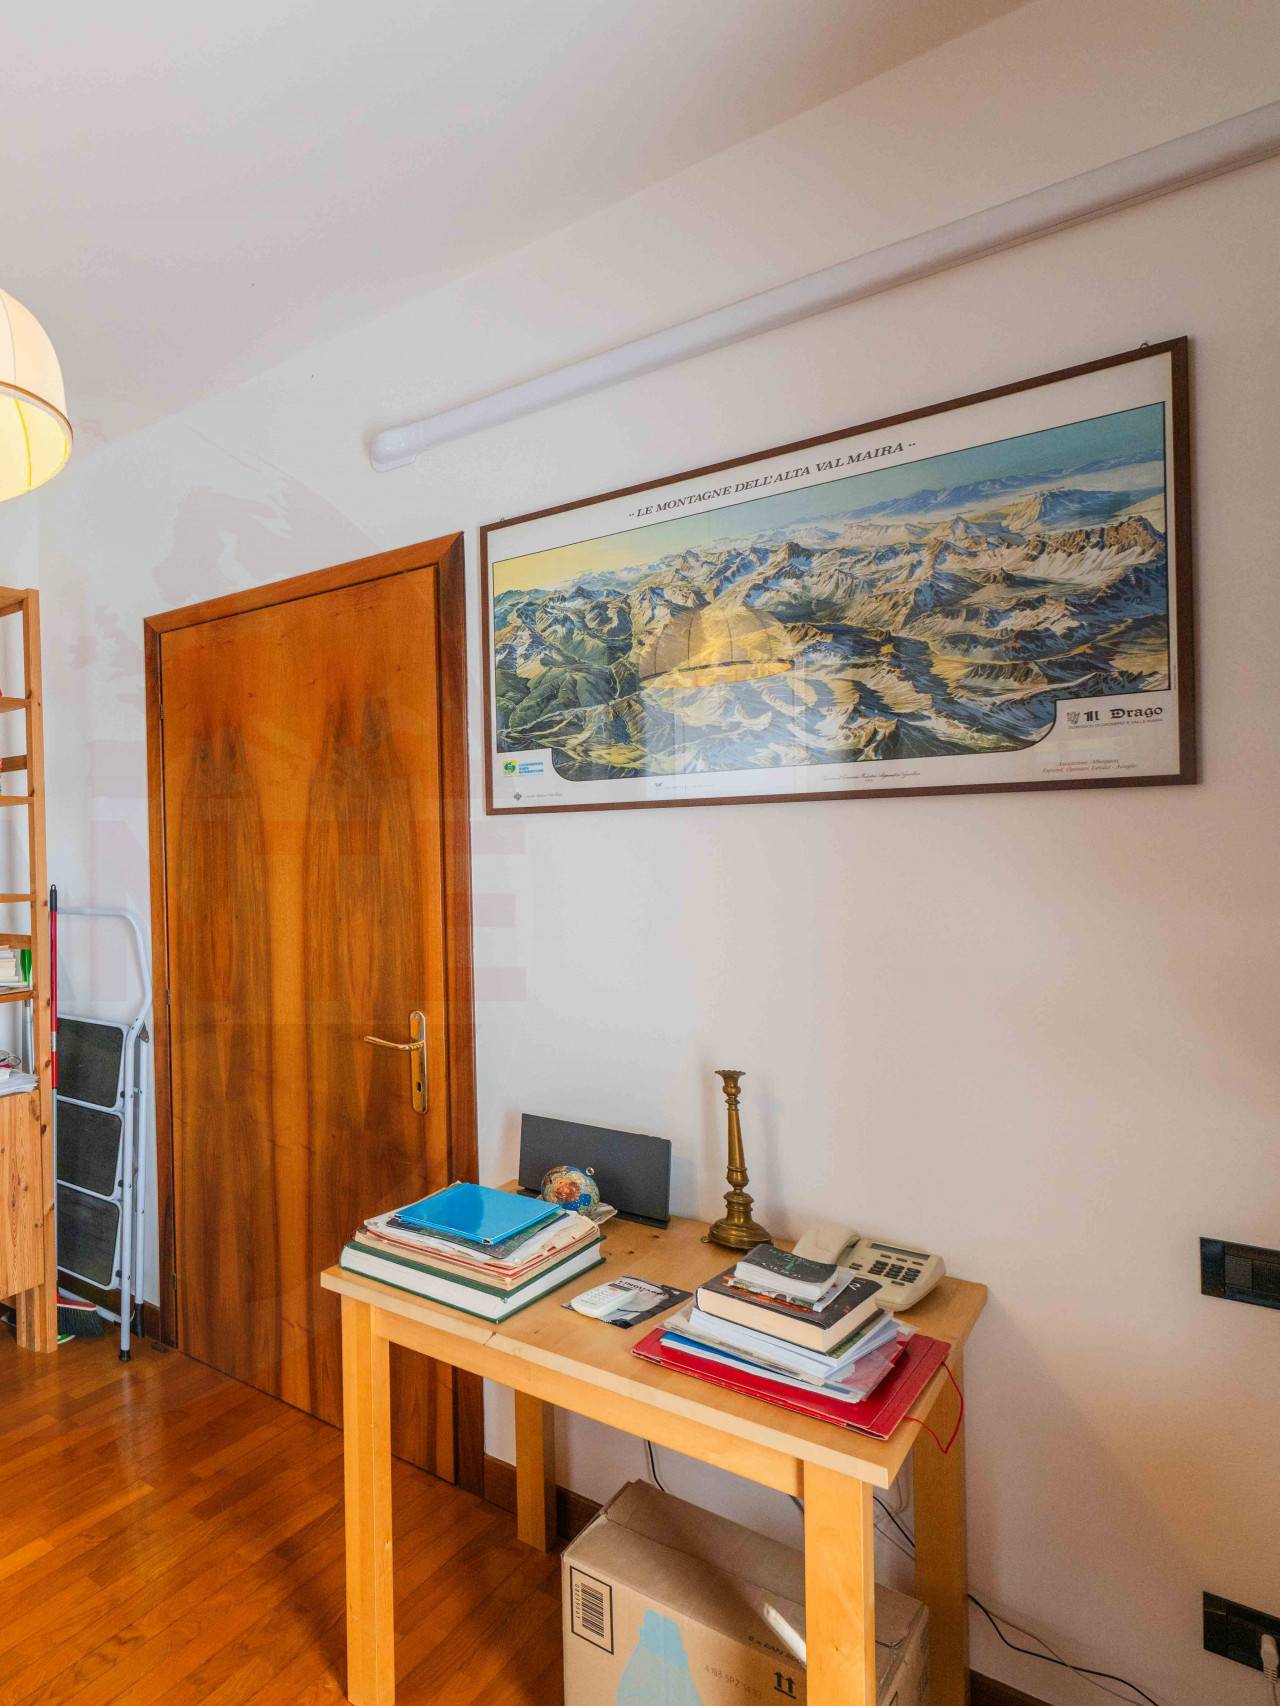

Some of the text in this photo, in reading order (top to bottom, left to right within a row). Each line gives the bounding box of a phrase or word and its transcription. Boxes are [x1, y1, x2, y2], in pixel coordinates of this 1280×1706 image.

[636, 506, 653, 518] LE
[656, 486, 732, 513] MONTAGNE
[816, 458, 844, 472] VAL
[847, 442, 904, 466] MAIRA
[1083, 706, 1164, 723] Il Drago
